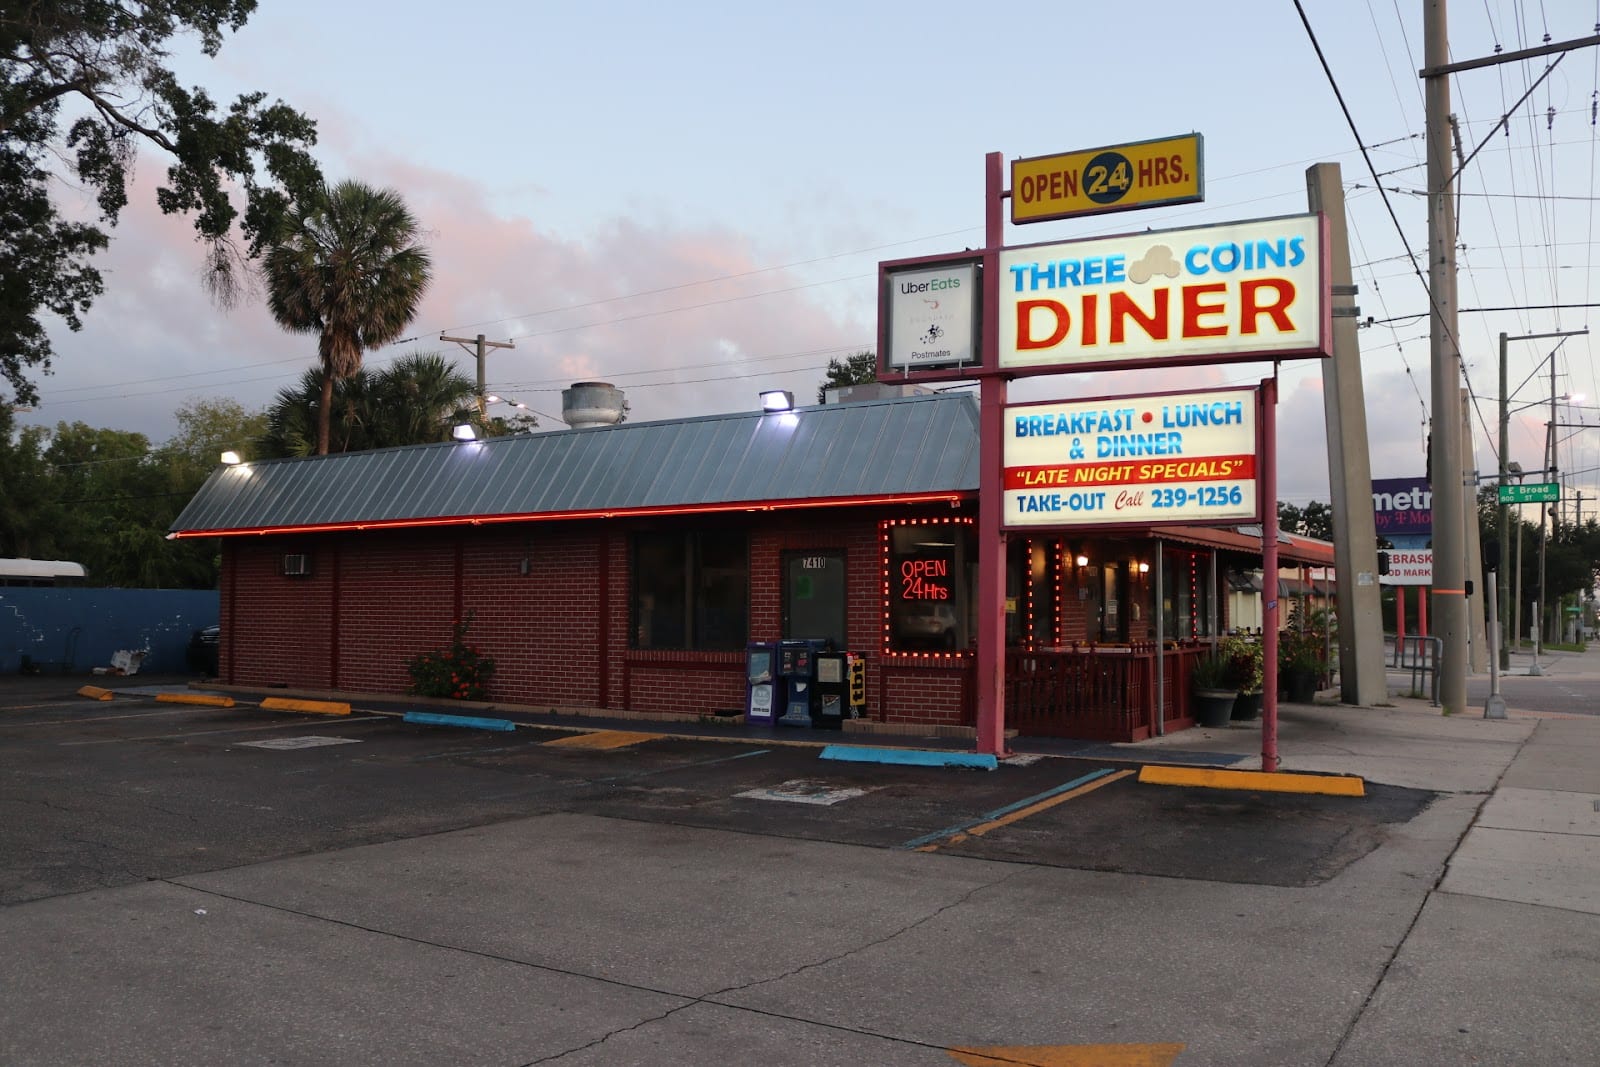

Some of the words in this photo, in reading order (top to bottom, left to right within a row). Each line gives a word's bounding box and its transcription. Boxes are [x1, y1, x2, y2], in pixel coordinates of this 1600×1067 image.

[1021, 169, 1078, 204] OPEN
[1088, 161, 1129, 195] 24
[1138, 154, 1190, 188] HRS.
[1009, 253, 1126, 292] THREE
[1184, 234, 1306, 275] COINS
[1014, 277, 1299, 351] DINER
[911, 349, 951, 359] Postmates
[1015, 408, 1136, 438] BREAKFAST
[1162, 401, 1242, 428] LUNCH
[1069, 437, 1084, 460] &
[1096, 431, 1183, 458] DINNER
[1080, 465, 1134, 483] NIGHT
[1017, 492, 1106, 513] TAKE-OUT
[1114, 489, 1143, 510] Call
[1151, 485, 1242, 509] 239-1256
[1508, 487, 1515, 495] E
[1519, 485, 1549, 494] Broad
[1375, 511, 1390, 528] by
[1410, 511, 1433, 524] Mo
[802, 556, 826, 569] 7410
[902, 559, 946, 578] OPEN
[902, 577, 924, 600] 24
[924, 583, 948, 600] Hrs
